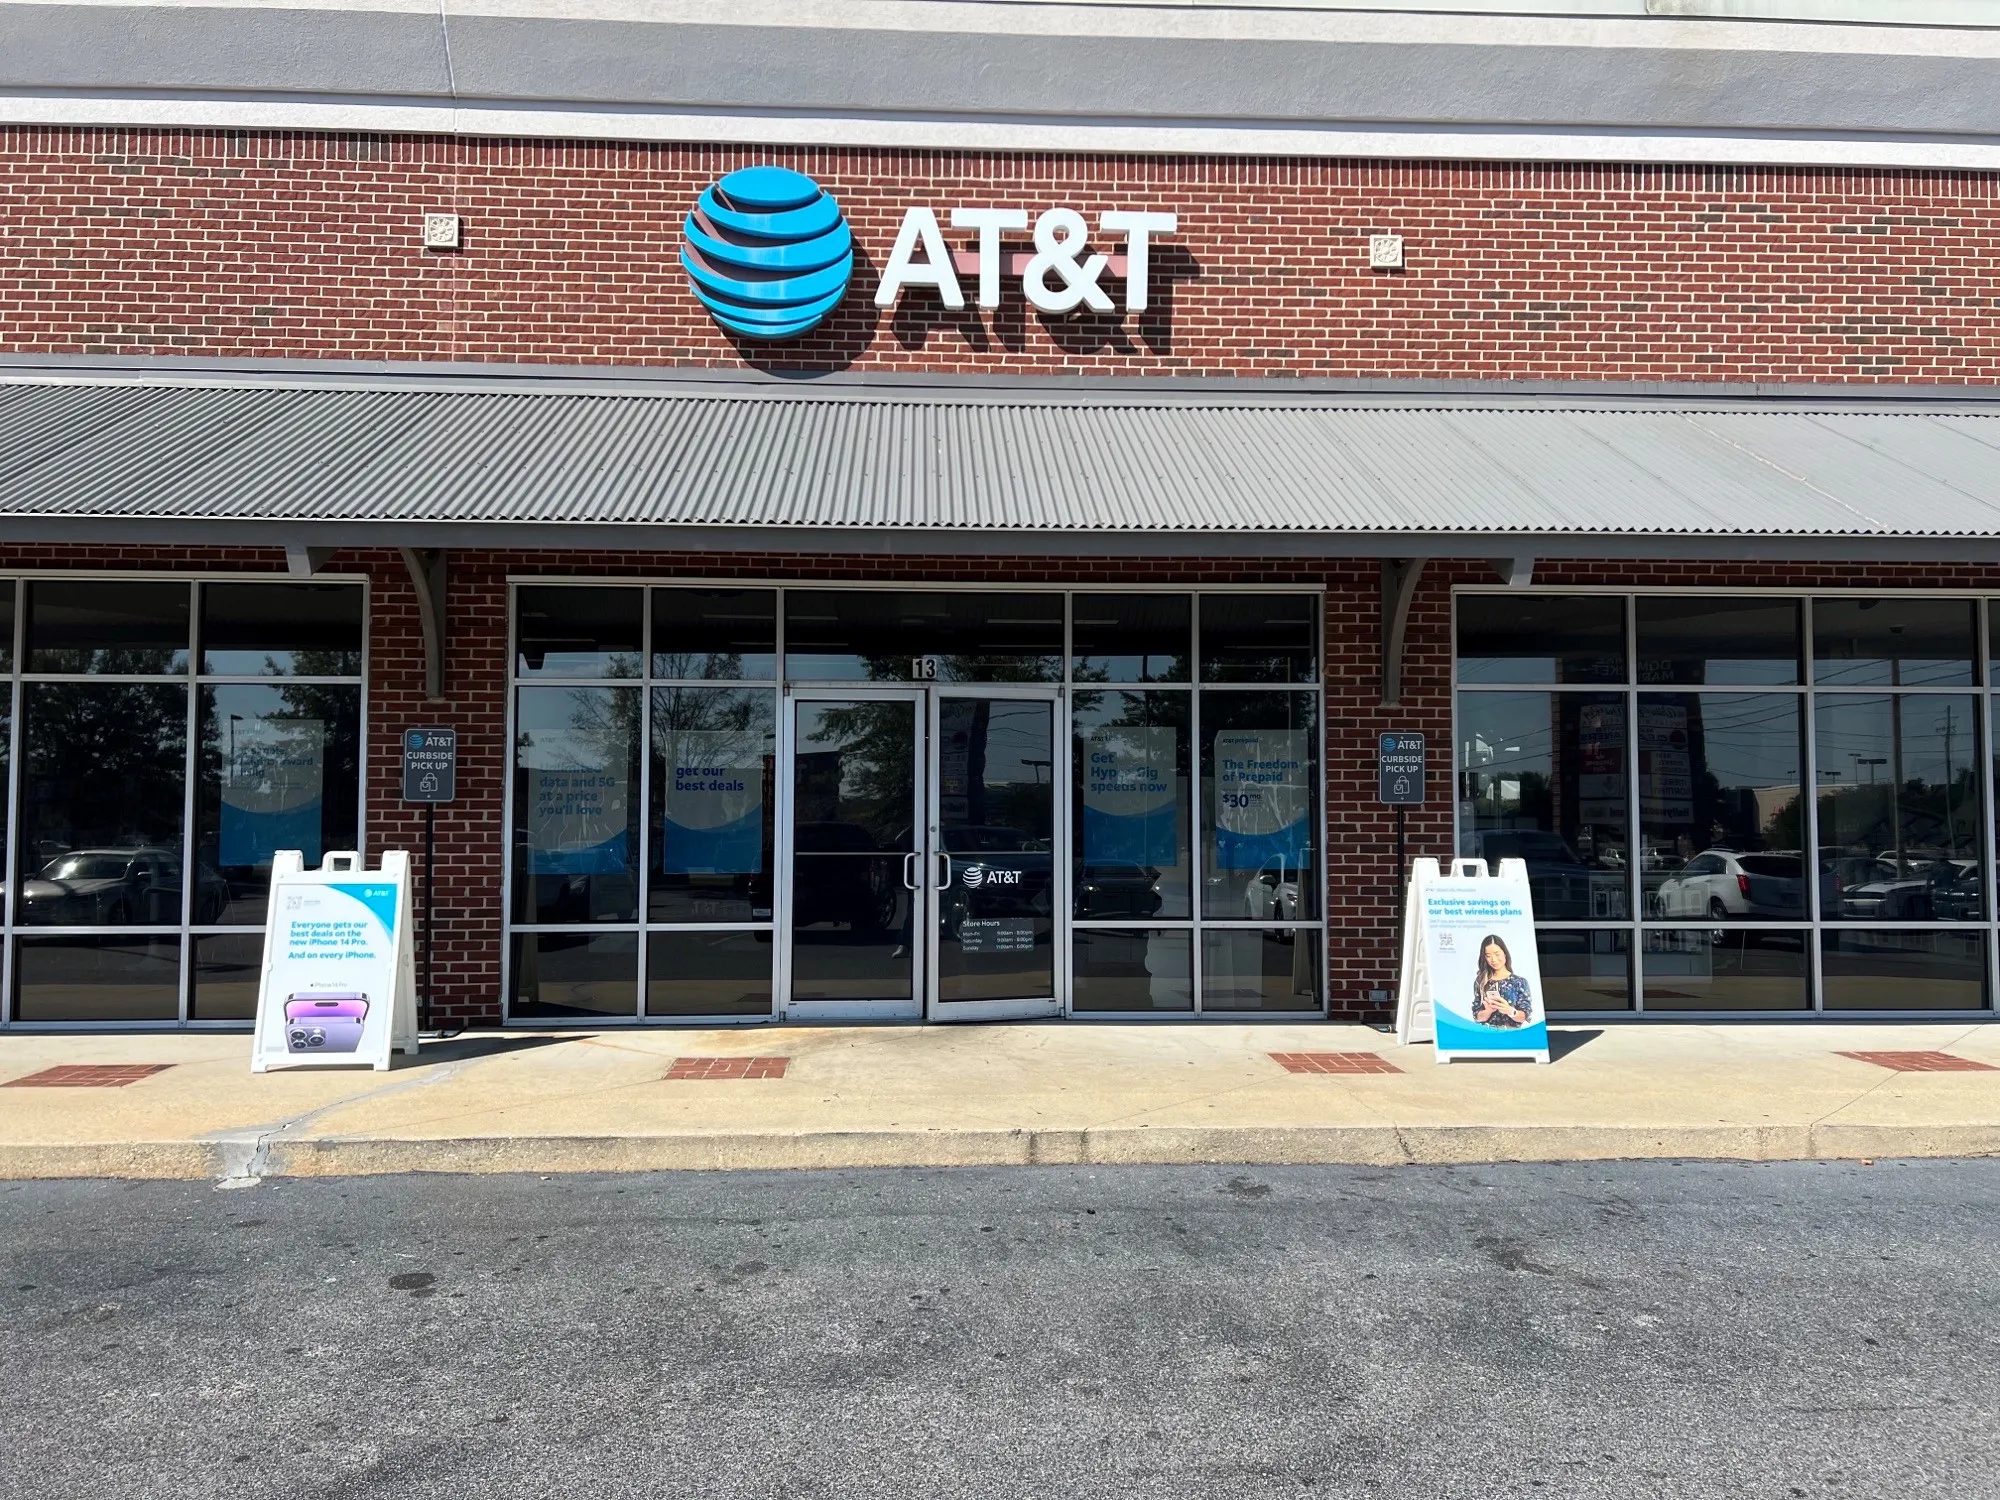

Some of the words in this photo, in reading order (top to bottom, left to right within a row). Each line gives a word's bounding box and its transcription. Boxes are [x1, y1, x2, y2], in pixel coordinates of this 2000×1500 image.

[874, 207, 1177, 312] AT&T
[915, 659, 936, 678] 13
[425, 736, 454, 747] AT&T
[1397, 740, 1422, 750] AT&T
[406, 752, 454, 760] CURBSIDE
[1090, 752, 1114, 764] Get
[411, 762, 433, 770] PICK
[435, 762, 448, 770] UP
[1222, 760, 1244, 769] The
[1247, 759, 1298, 769] Freedom
[676, 768, 698, 779] get
[702, 768, 726, 776] our
[1222, 772, 1236, 782] of
[1238, 772, 1283, 784] Prepaid
[540, 776, 568, 787] data
[572, 776, 596, 787] and
[598, 777, 616, 787] 5G
[676, 780, 705, 791] best
[708, 780, 744, 791] deals
[1090, 783, 1137, 794] speeds
[1140, 783, 1167, 792] now
[539, 791, 553, 801] at
[556, 793, 563, 801] a
[566, 790, 598, 804] price
[1222, 793, 1249, 808] $30
[538, 804, 572, 818] you'll
[576, 804, 602, 815] love
[986, 871, 1022, 884] AT&T
[1468, 899, 1498, 907] savings
[1500, 908, 1522, 916] plans
[291, 921, 331, 930] Everyone
[333, 922, 352, 930] gets
